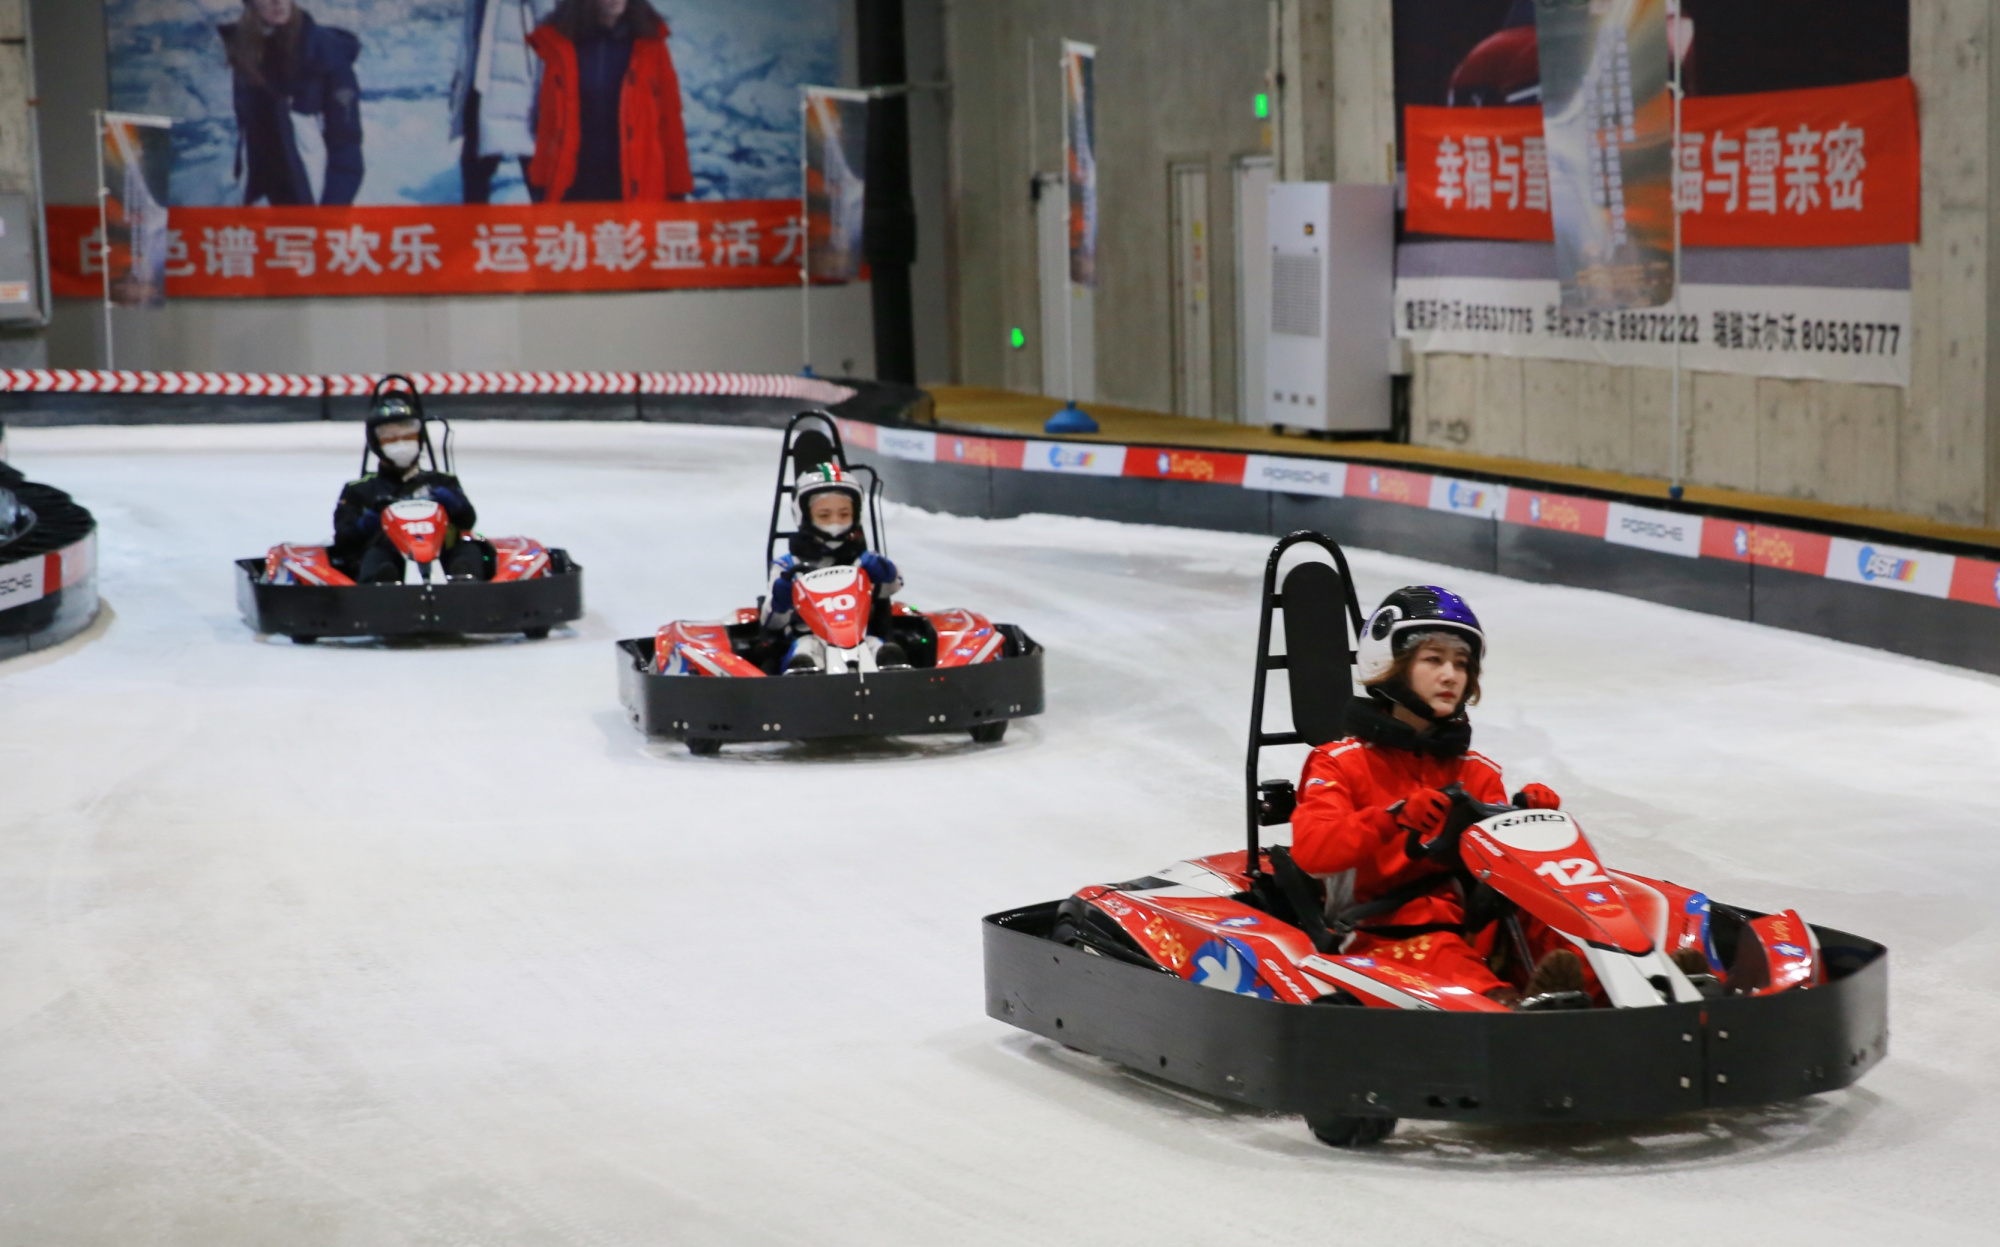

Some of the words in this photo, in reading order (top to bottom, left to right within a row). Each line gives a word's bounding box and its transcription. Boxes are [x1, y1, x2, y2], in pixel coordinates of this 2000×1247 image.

[1621, 517, 1684, 542] PORSCHE
[816, 594, 857, 613] 10
[1534, 858, 1612, 887] 12
